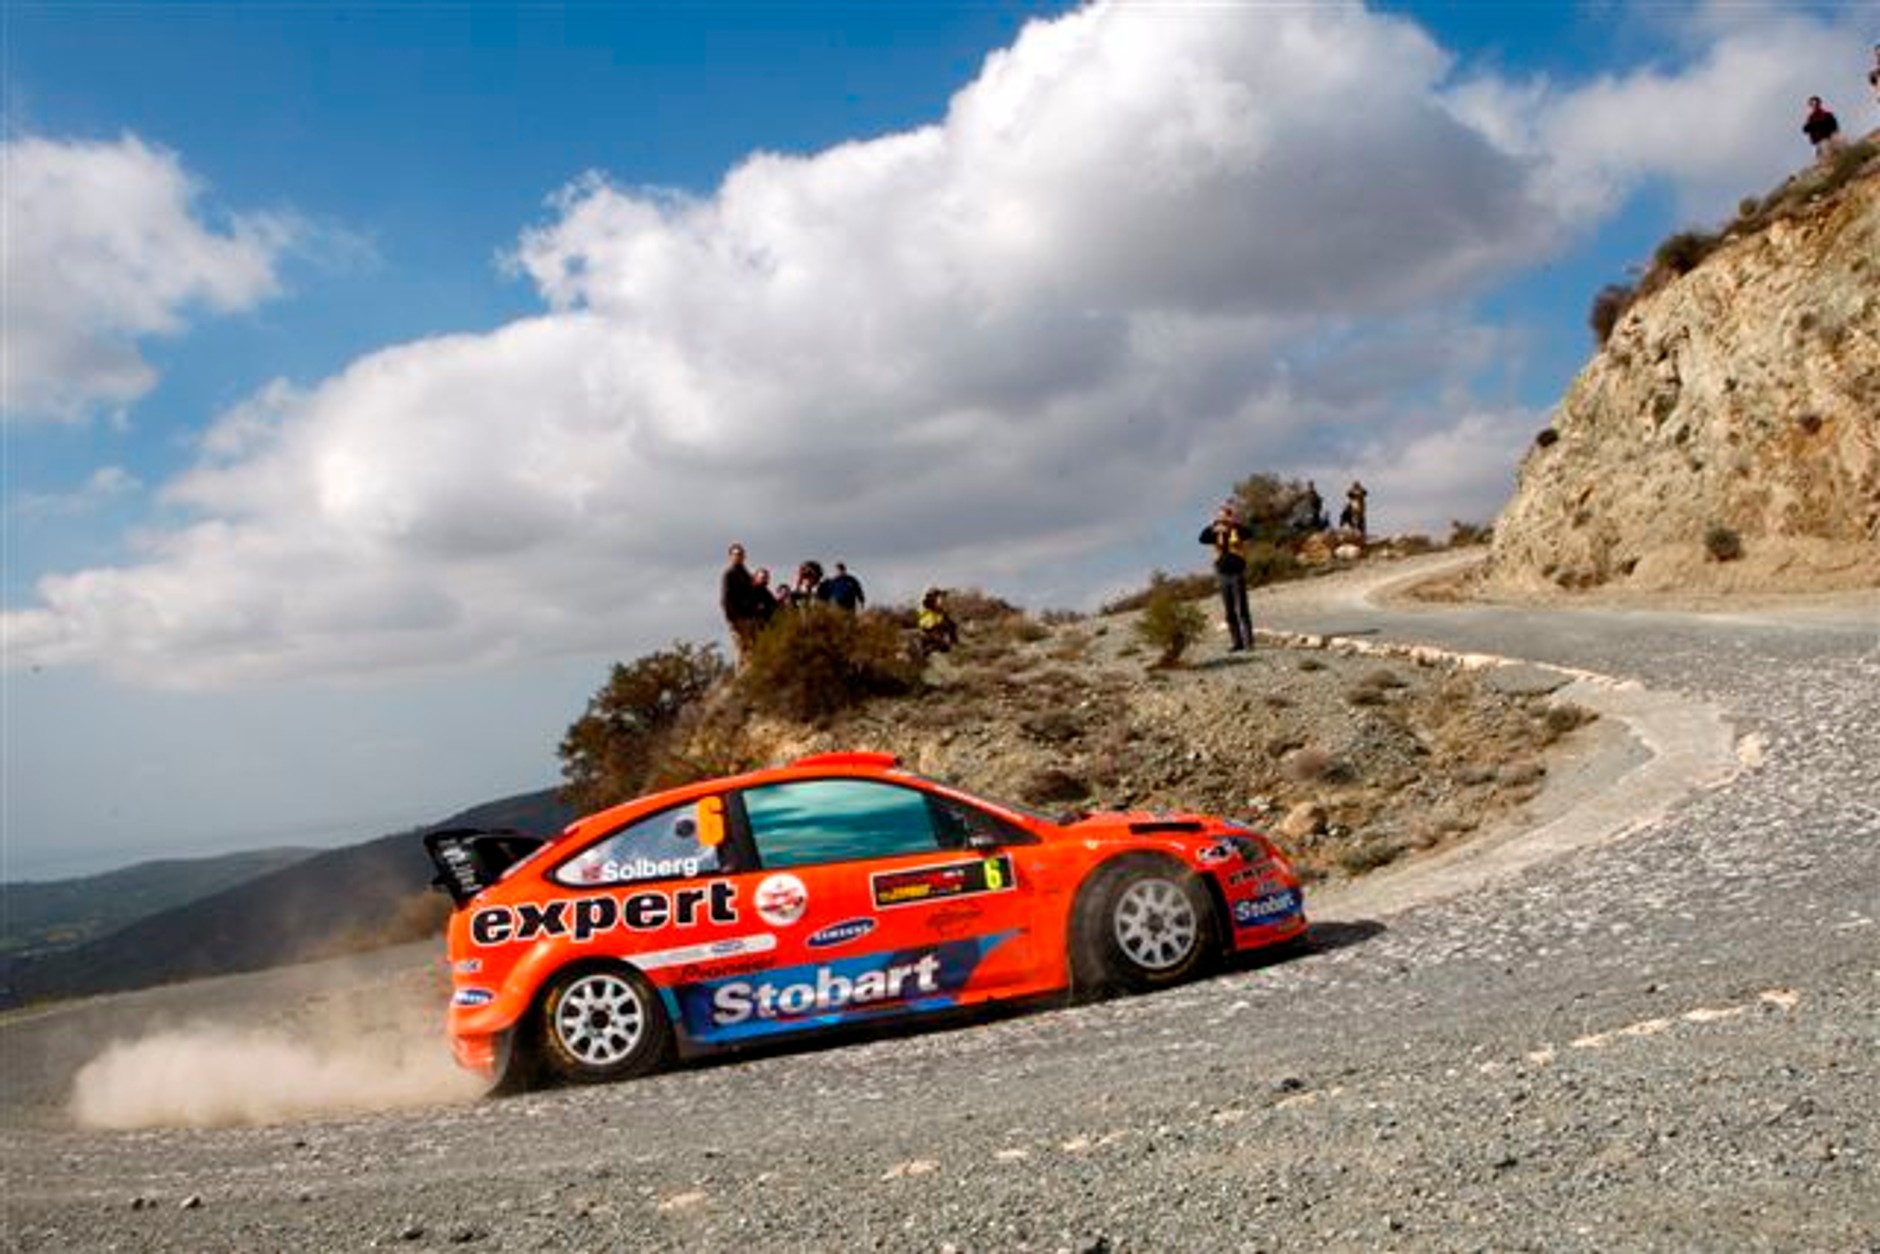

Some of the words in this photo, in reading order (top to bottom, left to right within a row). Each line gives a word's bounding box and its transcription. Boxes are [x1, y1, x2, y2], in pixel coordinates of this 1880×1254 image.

[697, 796, 725, 846] 6
[602, 857, 698, 882] Solberg
[984, 857, 1003, 893] 6
[471, 879, 738, 945] expert
[713, 953, 940, 1025] Stobart
